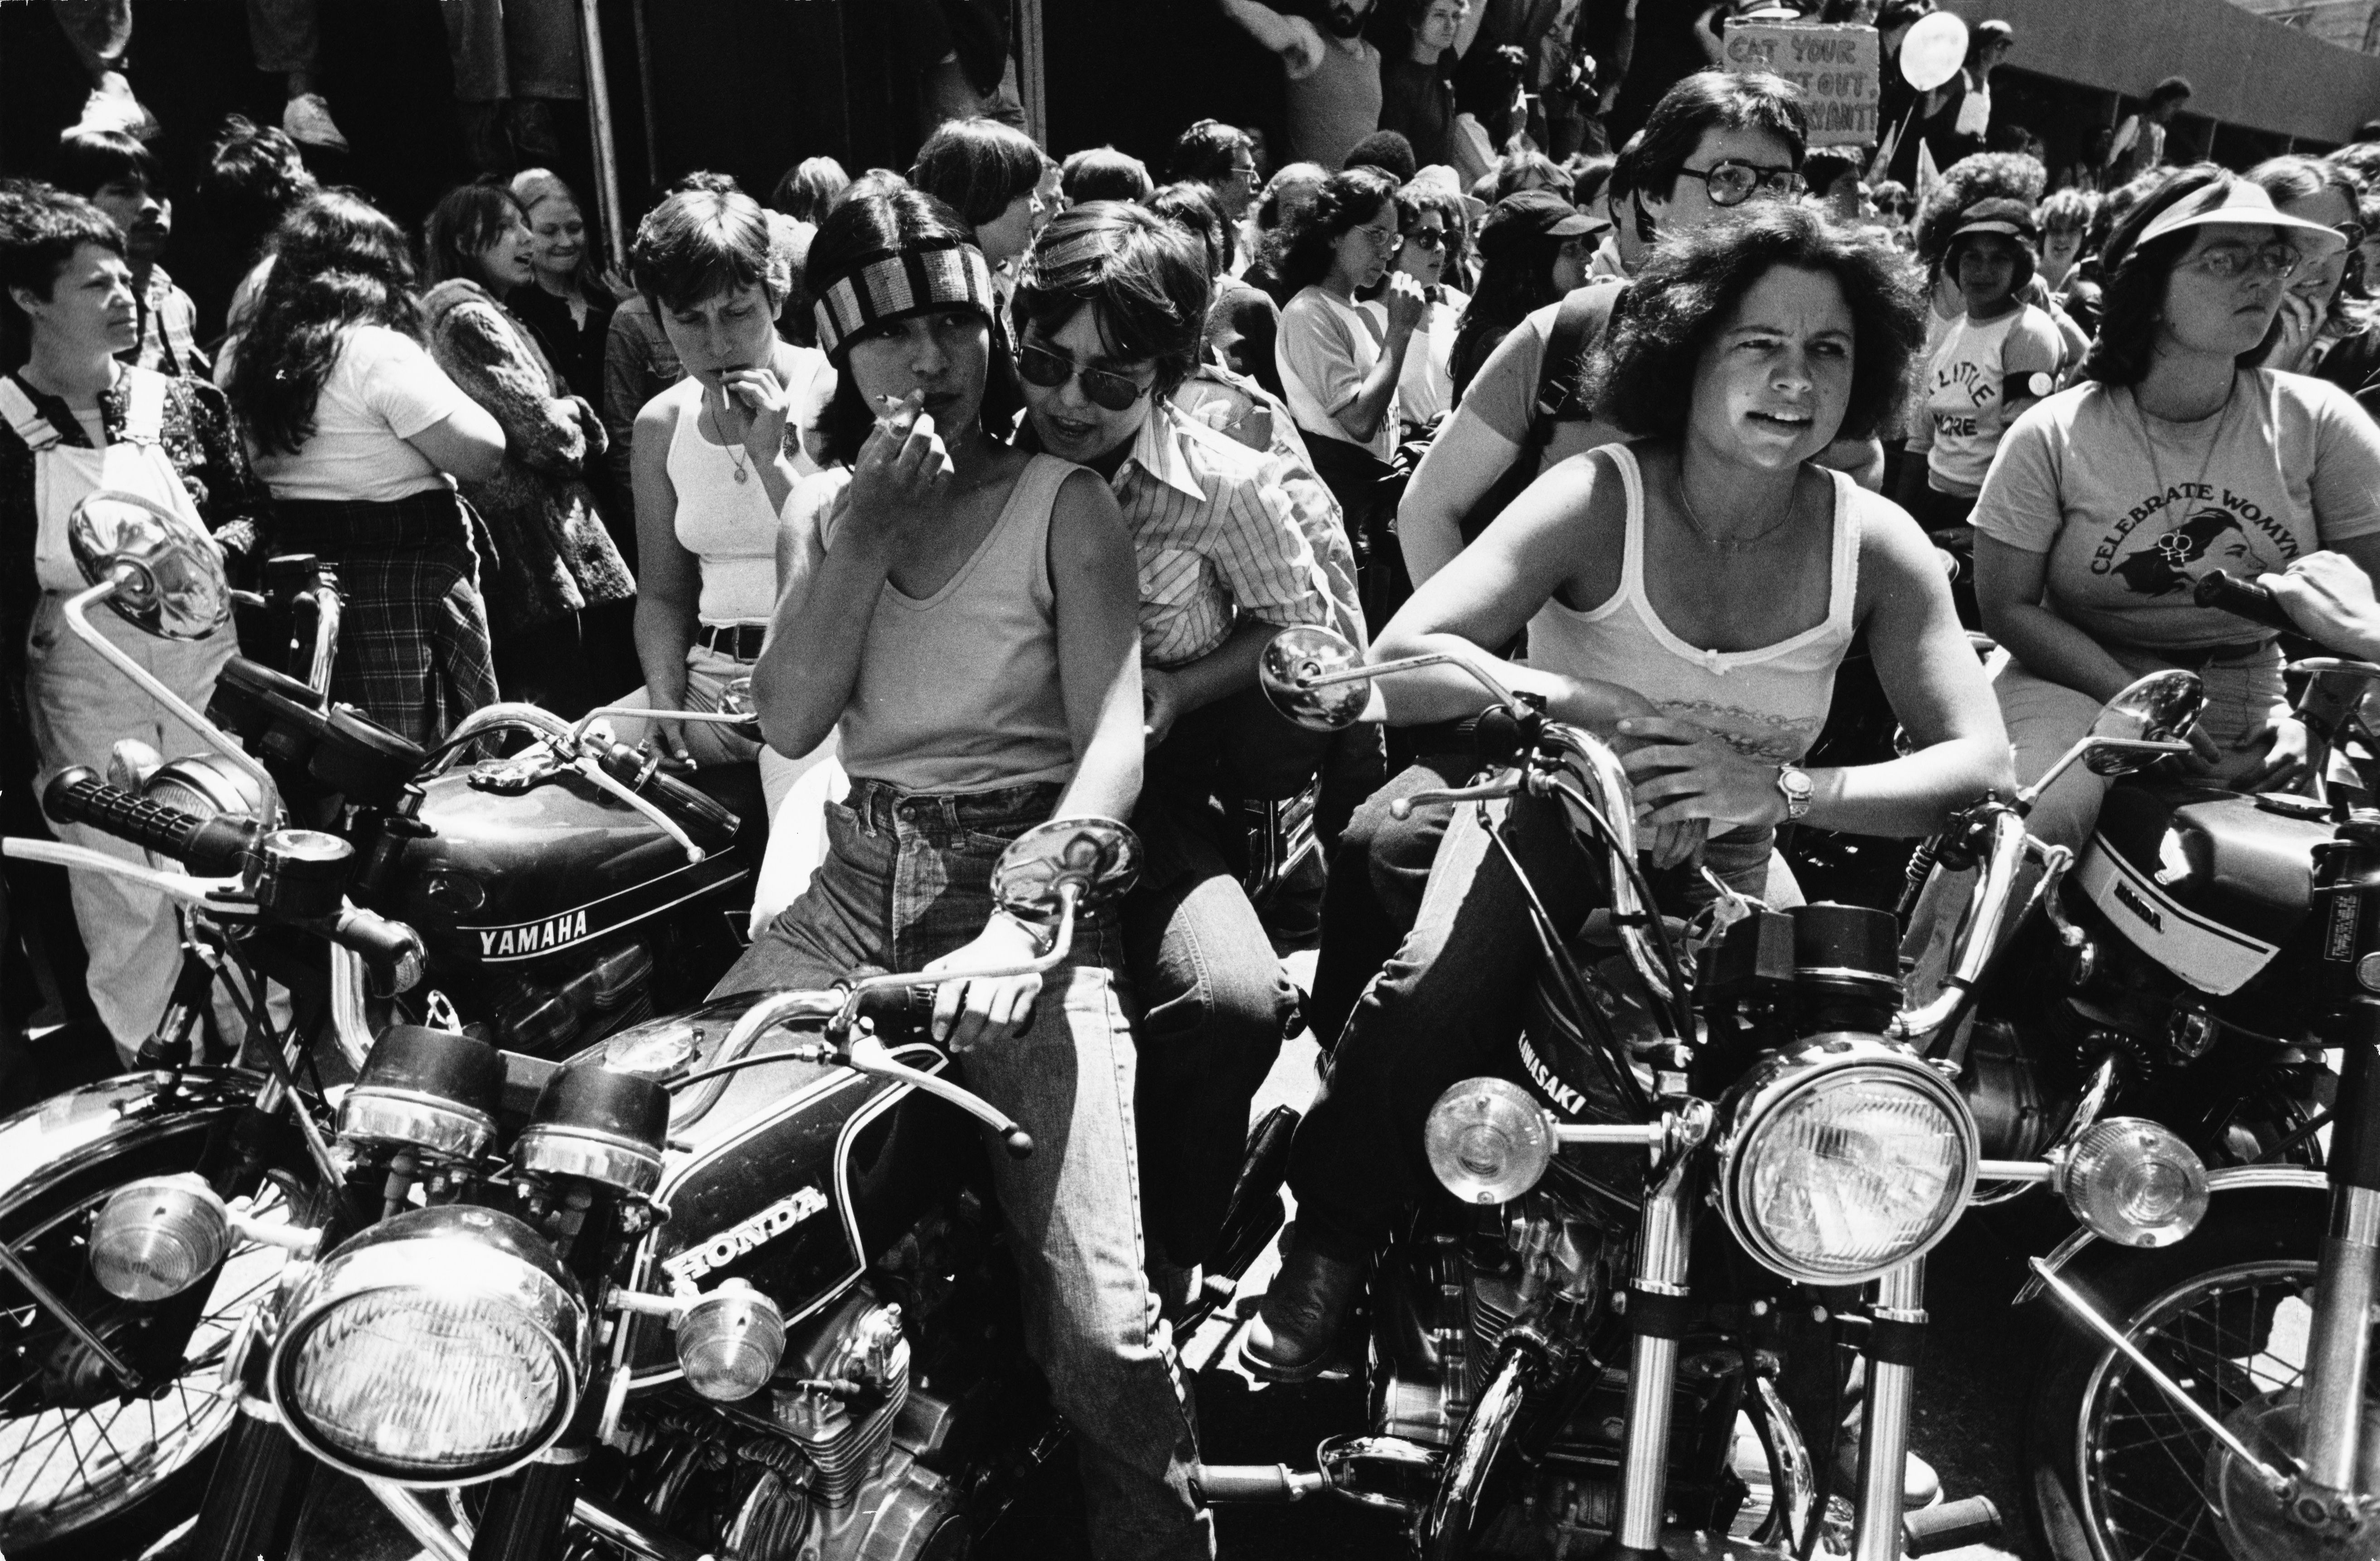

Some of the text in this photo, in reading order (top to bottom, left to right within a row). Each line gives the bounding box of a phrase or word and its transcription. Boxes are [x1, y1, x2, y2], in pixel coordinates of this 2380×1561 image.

[1791, 34, 1856, 64] YOUR
[1938, 361, 1996, 407] LITTLE
[2091, 483, 2299, 575] CELEBRATE WOMYN
[480, 910, 587, 955] YAMAHA
[661, 1185, 828, 1290] HONDA
